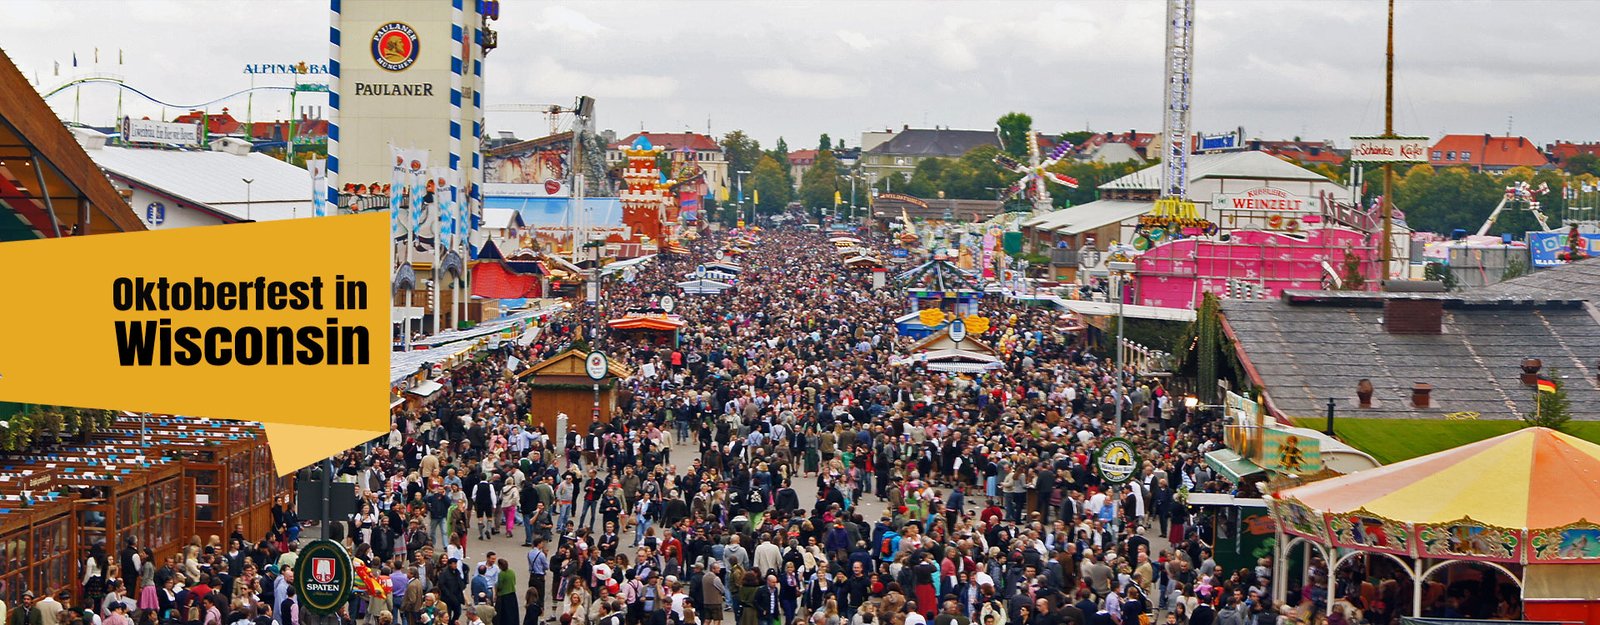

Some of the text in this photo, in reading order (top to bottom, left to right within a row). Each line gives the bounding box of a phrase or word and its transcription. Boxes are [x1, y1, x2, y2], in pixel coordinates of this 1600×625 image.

[373, 23, 417, 41] PAULANER
[243, 63, 297, 74] ALPINA
[355, 82, 434, 97] PAULANER
[1232, 198, 1303, 210] WEINZELT
